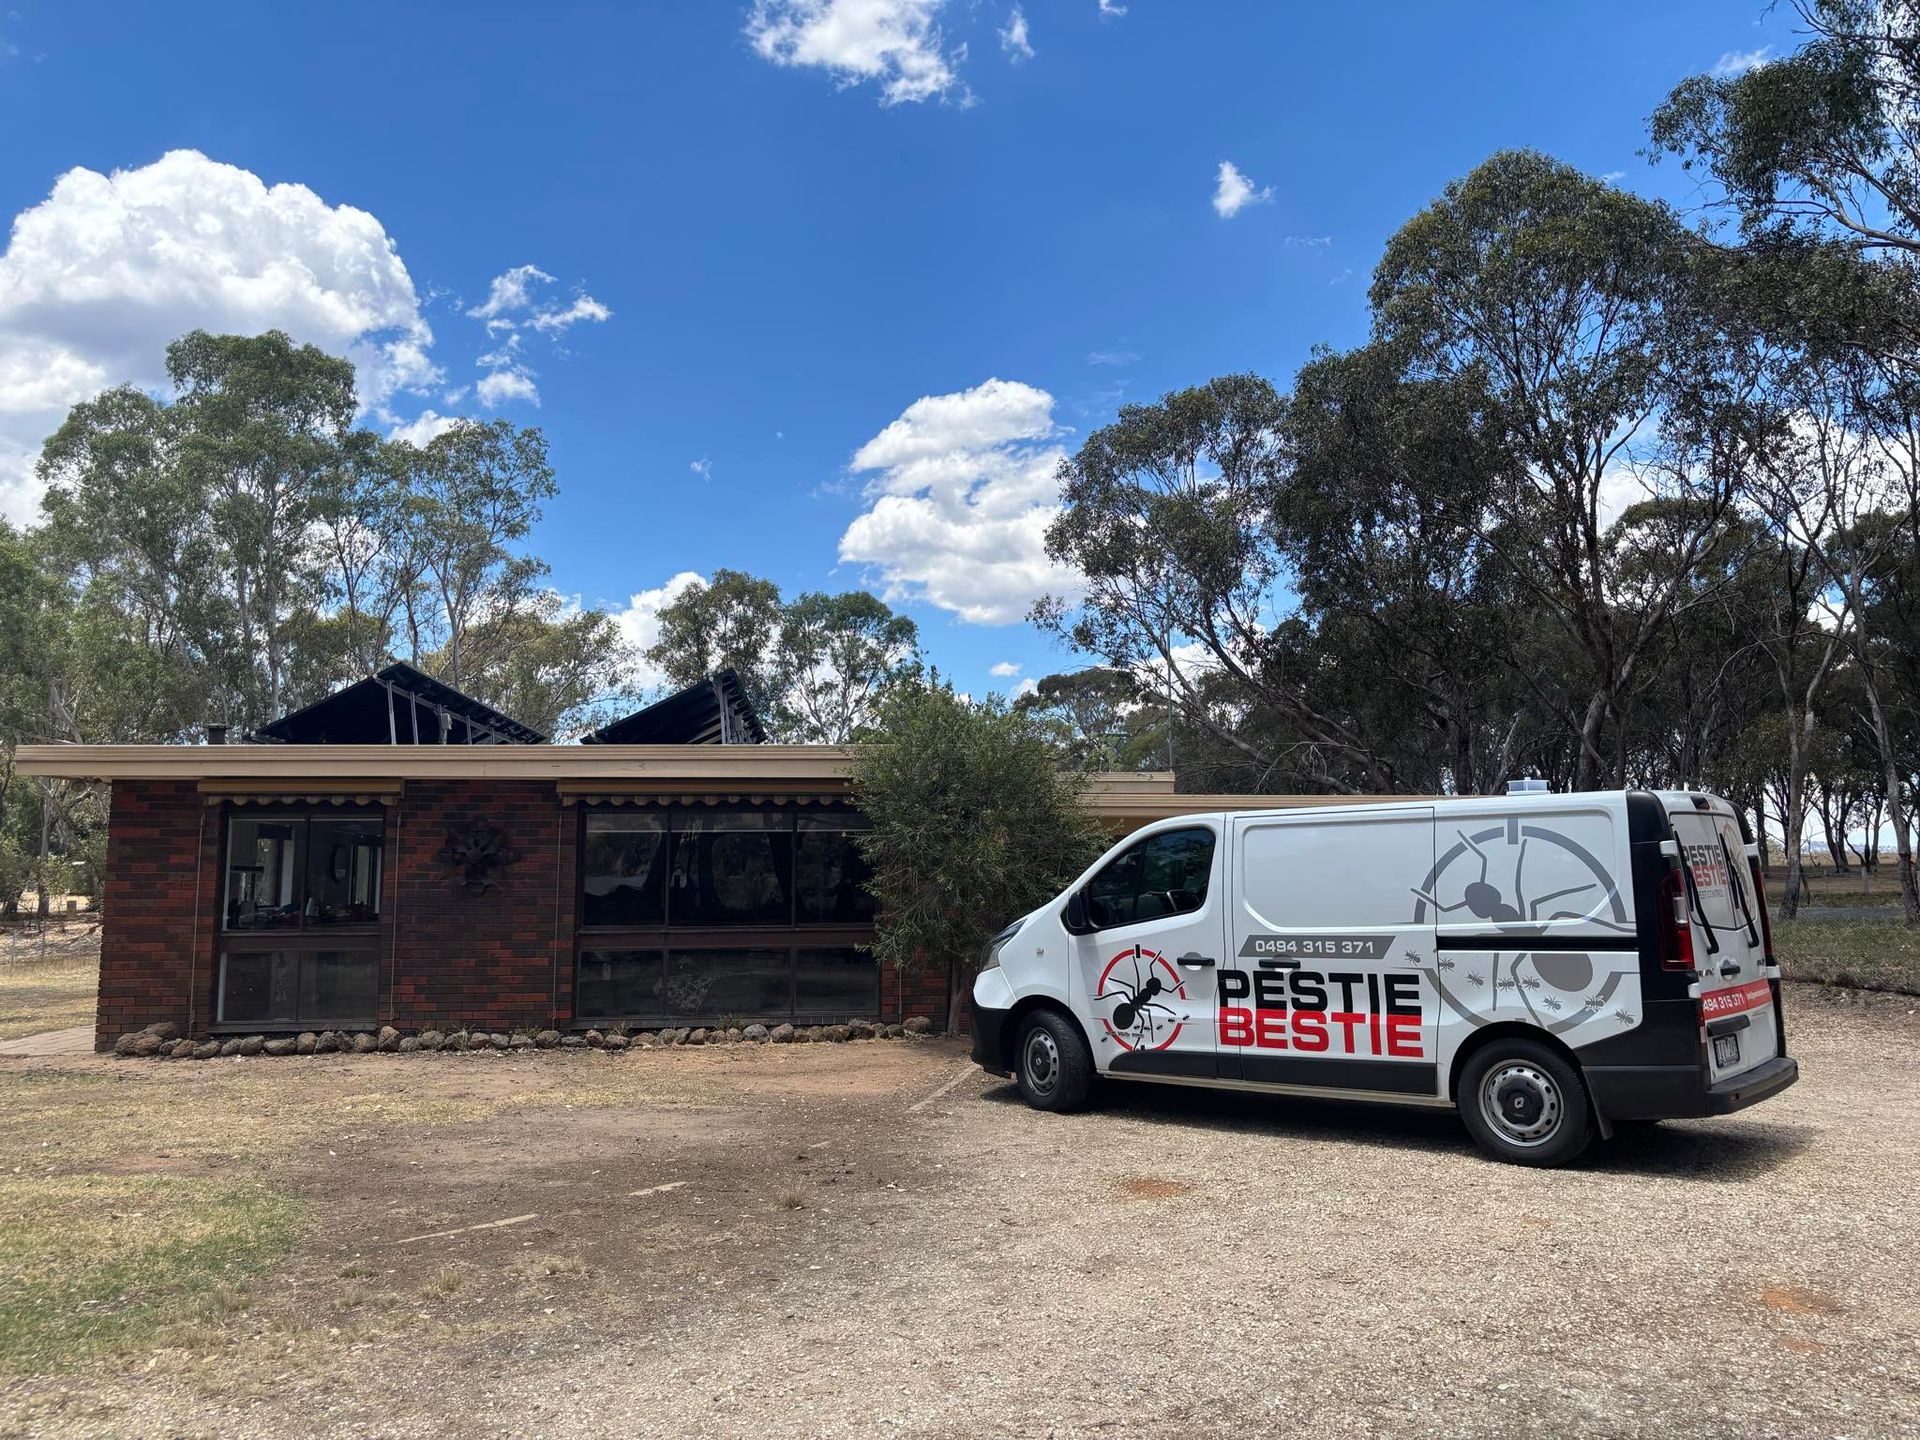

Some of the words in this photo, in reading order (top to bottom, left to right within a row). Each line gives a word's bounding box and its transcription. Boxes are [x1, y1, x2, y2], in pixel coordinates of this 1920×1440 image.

[1681, 844, 1724, 866] PESTIE
[1690, 864, 1728, 887] ESTIE
[1255, 940, 1297, 953] 0494
[1303, 941, 1336, 953] 315
[1342, 941, 1374, 954] 371
[1217, 969, 1421, 1015] PESTIE
[1703, 996, 1719, 1012] 494
[1720, 994, 1733, 1009] 315
[1733, 992, 1744, 1006] 371
[1219, 1006, 1423, 1058] BESTIE
